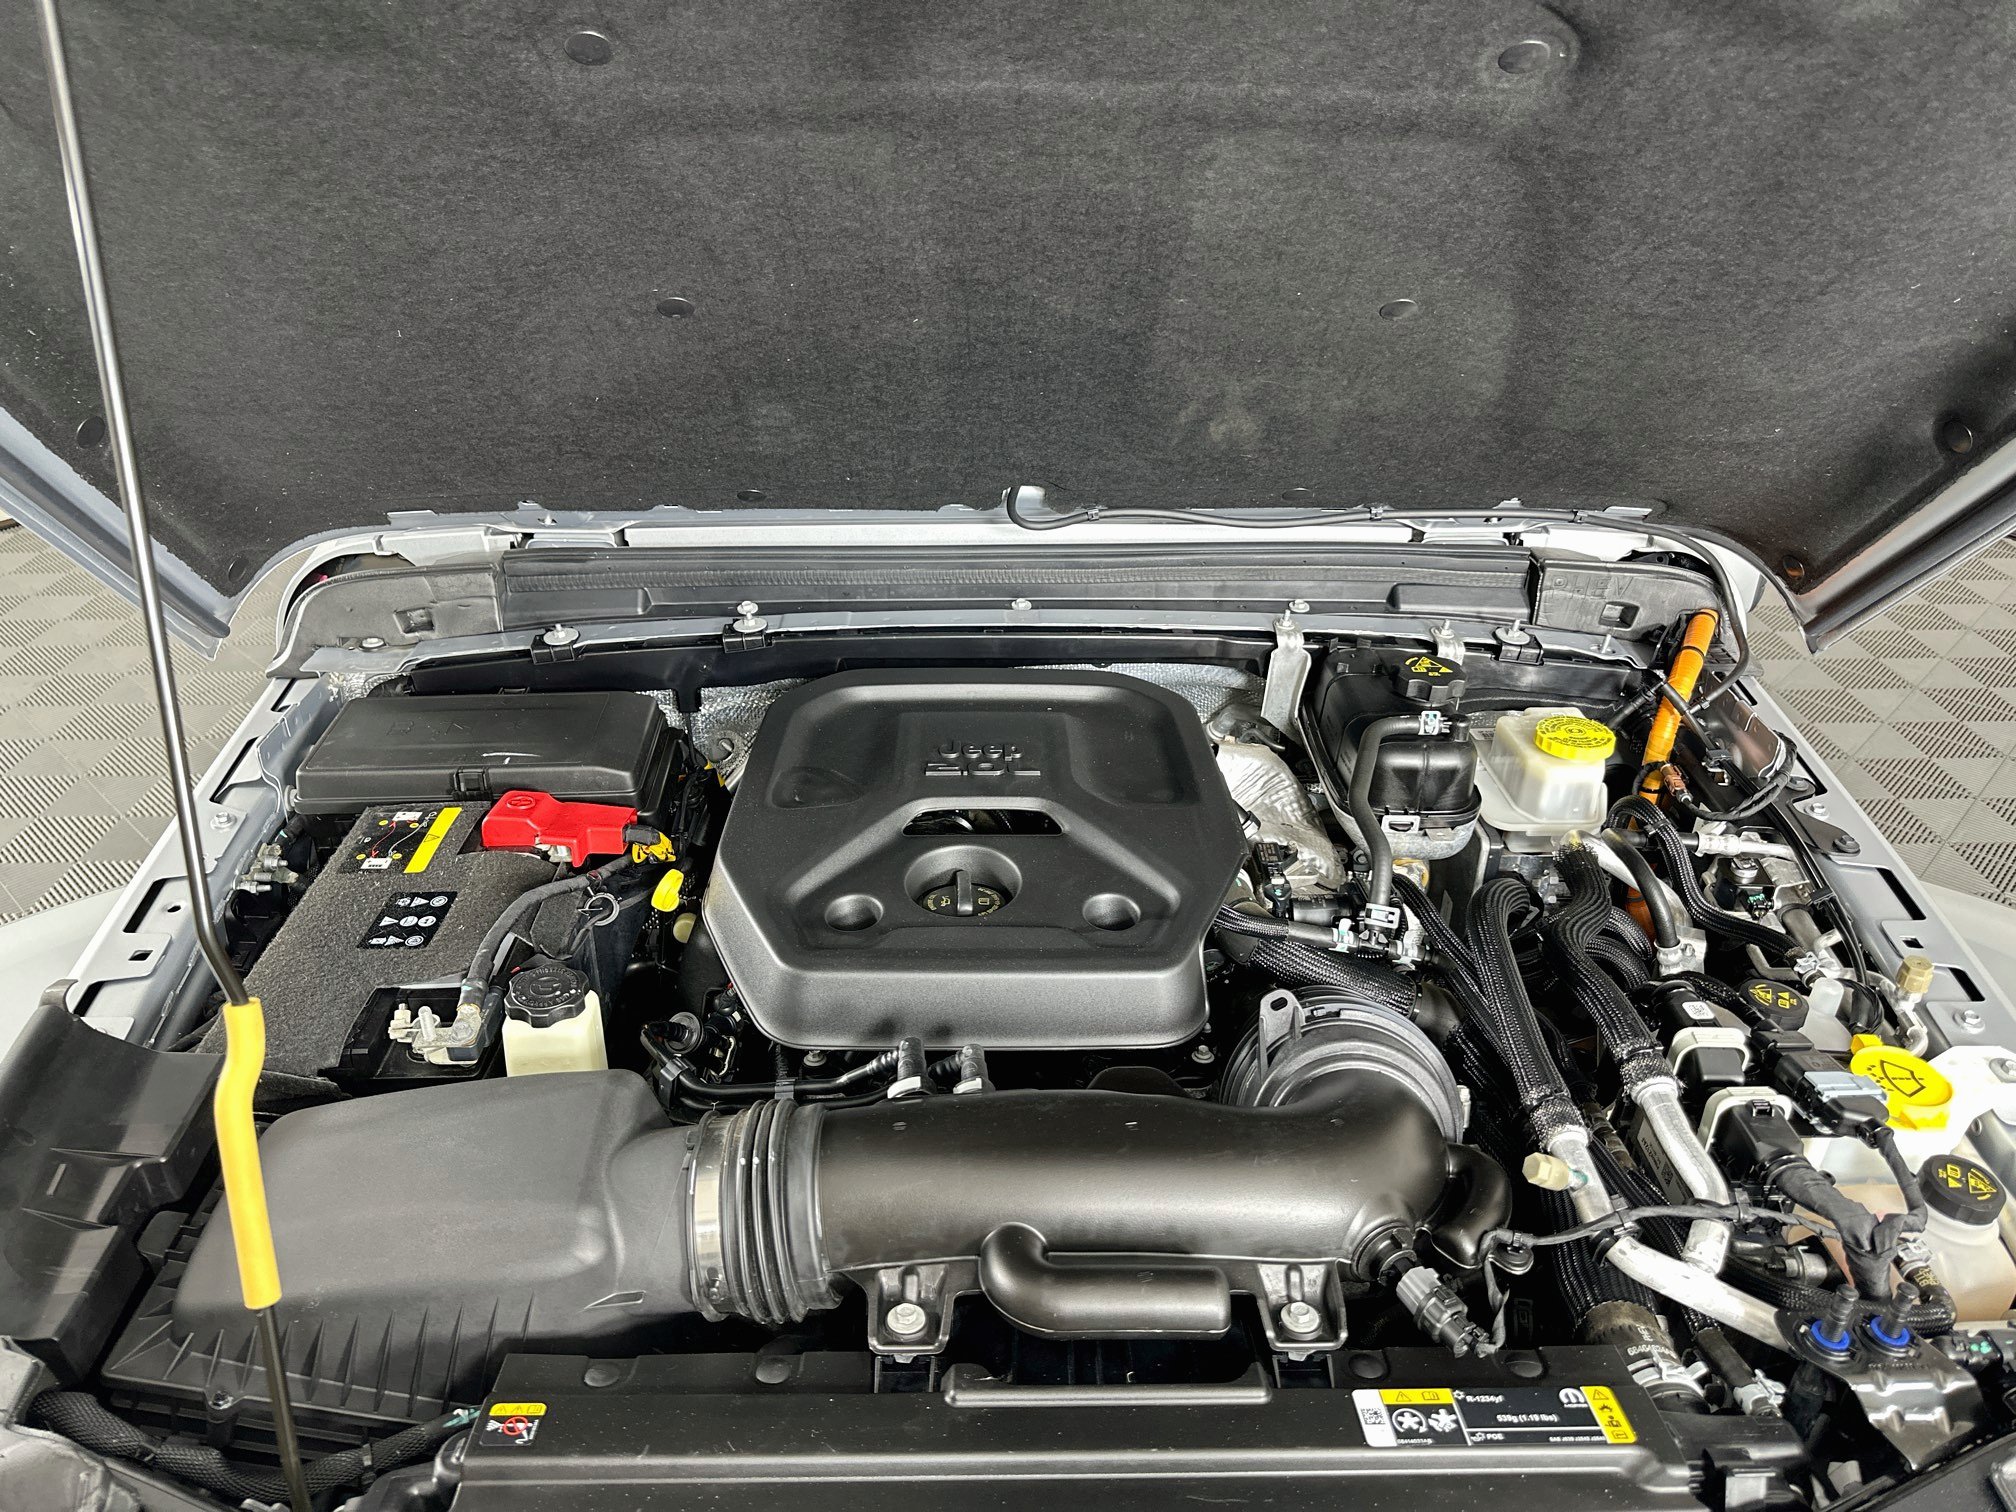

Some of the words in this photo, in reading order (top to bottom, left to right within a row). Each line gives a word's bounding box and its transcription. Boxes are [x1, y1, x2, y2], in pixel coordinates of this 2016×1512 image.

[938, 739, 1024, 761] Jeep
[924, 761, 1041, 776] 2.0L
[1465, 1394, 1504, 1404] R-1234yf
[1496, 1414, 1518, 1423] 539g
[1540, 1413, 1559, 1423] lbs)
